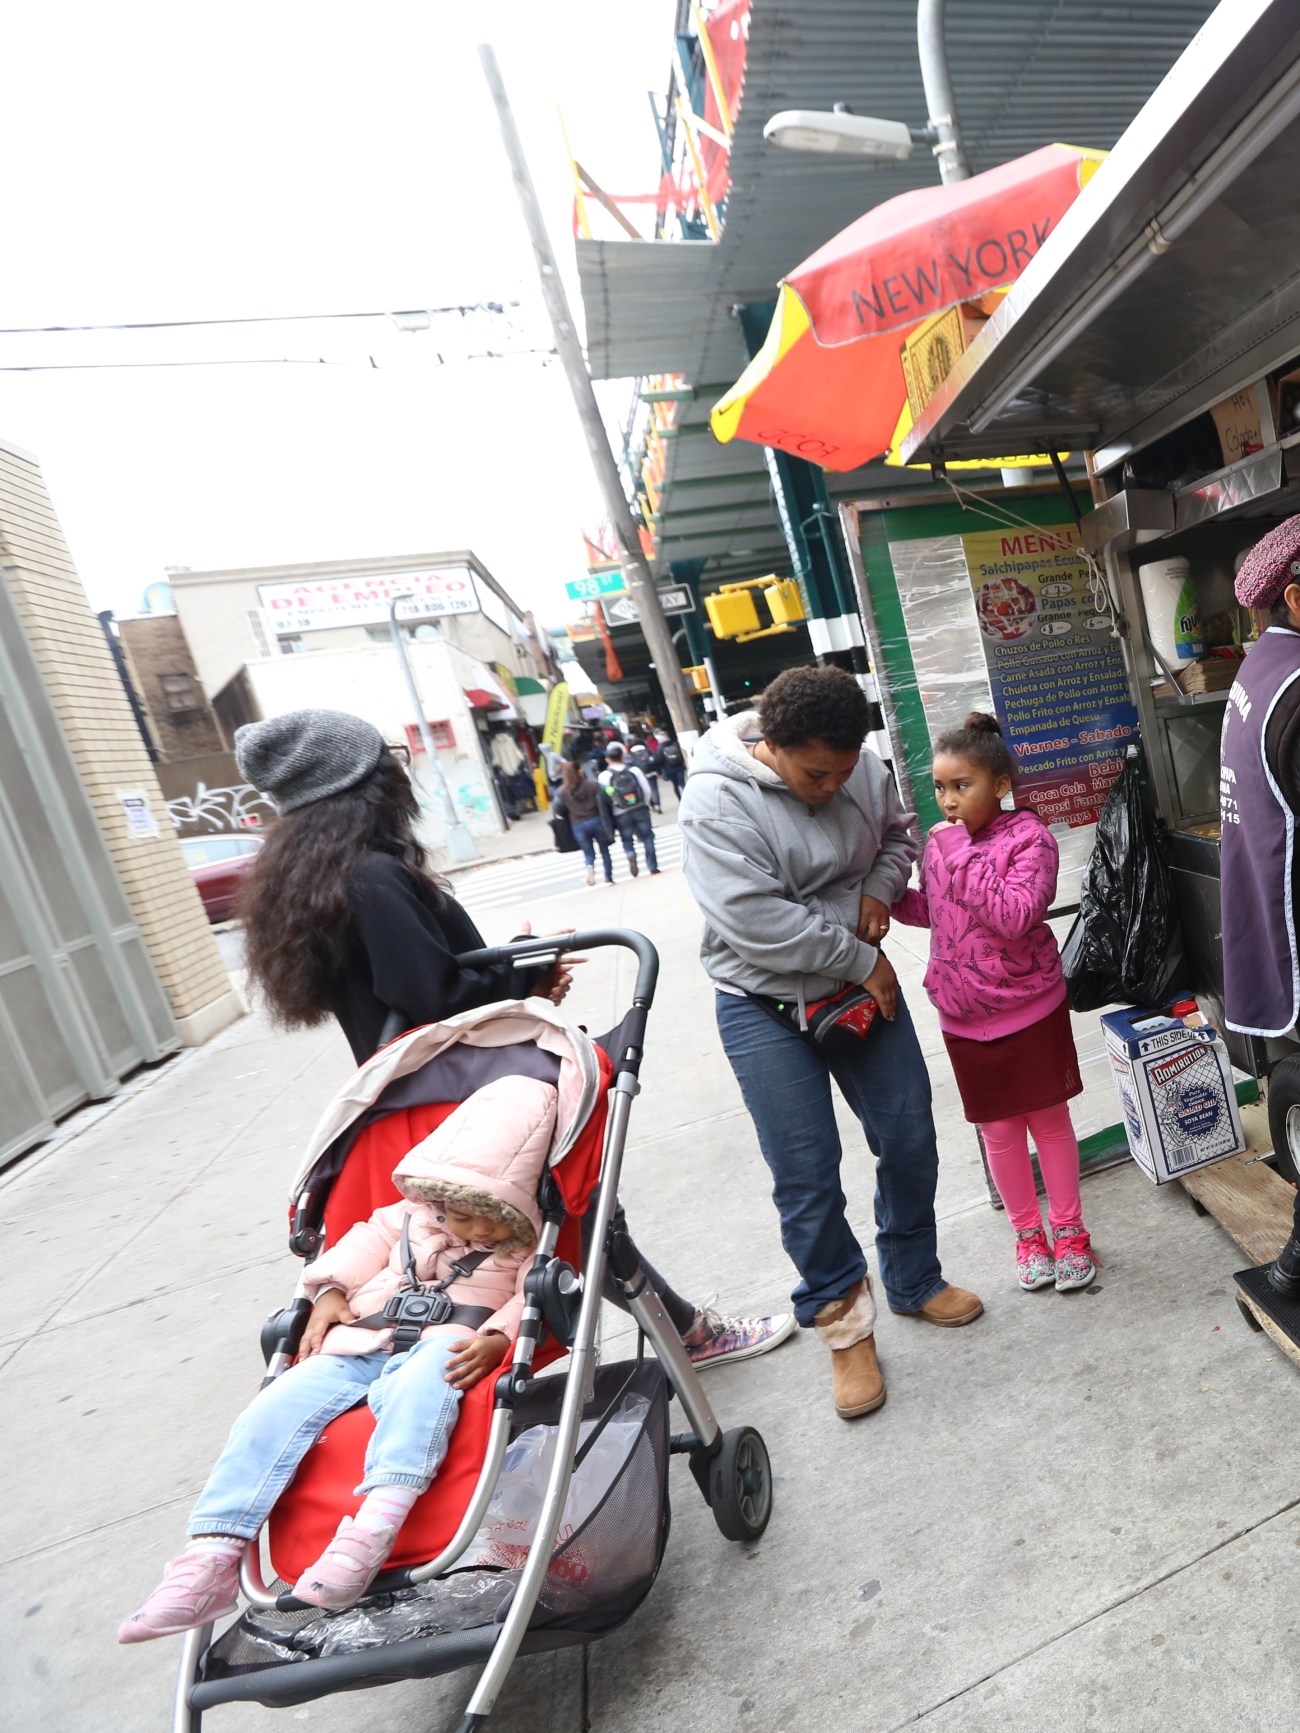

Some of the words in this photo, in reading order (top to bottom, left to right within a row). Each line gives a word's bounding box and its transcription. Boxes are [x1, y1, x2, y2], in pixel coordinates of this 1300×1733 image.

[850, 257, 942, 326] NEW
[947, 216, 1051, 290] YORK
[1000, 531, 1074, 557] MENU
[980, 558, 1052, 576] Salchipapas
[293, 574, 443, 594] AGENCIA
[574, 580, 601, 596] 98
[1038, 572, 1073, 584] Grande
[271, 596, 316, 610] DE
[1041, 597, 1077, 611] Papas
[994, 643, 1028, 656] Chuzos
[1030, 641, 1041, 651] de
[1042, 637, 1066, 649] Pollo
[1075, 635, 1090, 645] Res
[997, 658, 1021, 671] Pollo
[1023, 653, 1059, 667] Guisado
[1061, 650, 1077, 660] con
[1000, 671, 1026, 683] Carne
[1028, 666, 1056, 679] Asada
[1057, 663, 1073, 673] con
[1075, 660, 1099, 671] Arroz
[1002, 683, 1038, 696] Chuleta
[1039, 681, 1056, 691] con
[1057, 676, 1081, 687] Arroz
[1004, 695, 1043, 709] Pechuga
[1045, 692, 1057, 702] de
[1058, 689, 1081, 701] Pollo
[1082, 686, 1098, 696] con
[1100, 681, 1124, 693] Arroz
[1007, 710, 1031, 722] Pollo
[1032, 706, 1054, 718] Frito
[1055, 703, 1071, 714] con
[1073, 699, 1097, 711] Arroz
[1104, 693, 1130, 705] Ensala
[1010, 719, 1058, 736] Empanada
[1060, 716, 1071, 726] de
[1072, 713, 1101, 725] Queso
[1013, 737, 1070, 757] Viernes
[1079, 724, 1132, 745] Sabado
[1017, 760, 1055, 774] Pescado
[1056, 756, 1077, 768] Frito
[1078, 754, 1094, 763] con
[1096, 748, 1119, 760] Arroz
[1088, 758, 1125, 777] Bebi
[1029, 790, 1059, 803] Coca
[1060, 781, 1086, 795] Cola
[1037, 800, 1070, 816] Pepsi
[1074, 793, 1106, 808] Fanta
[1151, 1034, 1169, 1049] THIS
[1170, 1030, 1187, 1043] SIDE
[1154, 1046, 1206, 1084] ADMIRATION
[1178, 1104, 1203, 1118] SALAD
[1203, 1099, 1217, 1109] OIL
[1184, 1117, 1198, 1125] SOYA
[1199, 1110, 1213, 1119] BEAN
